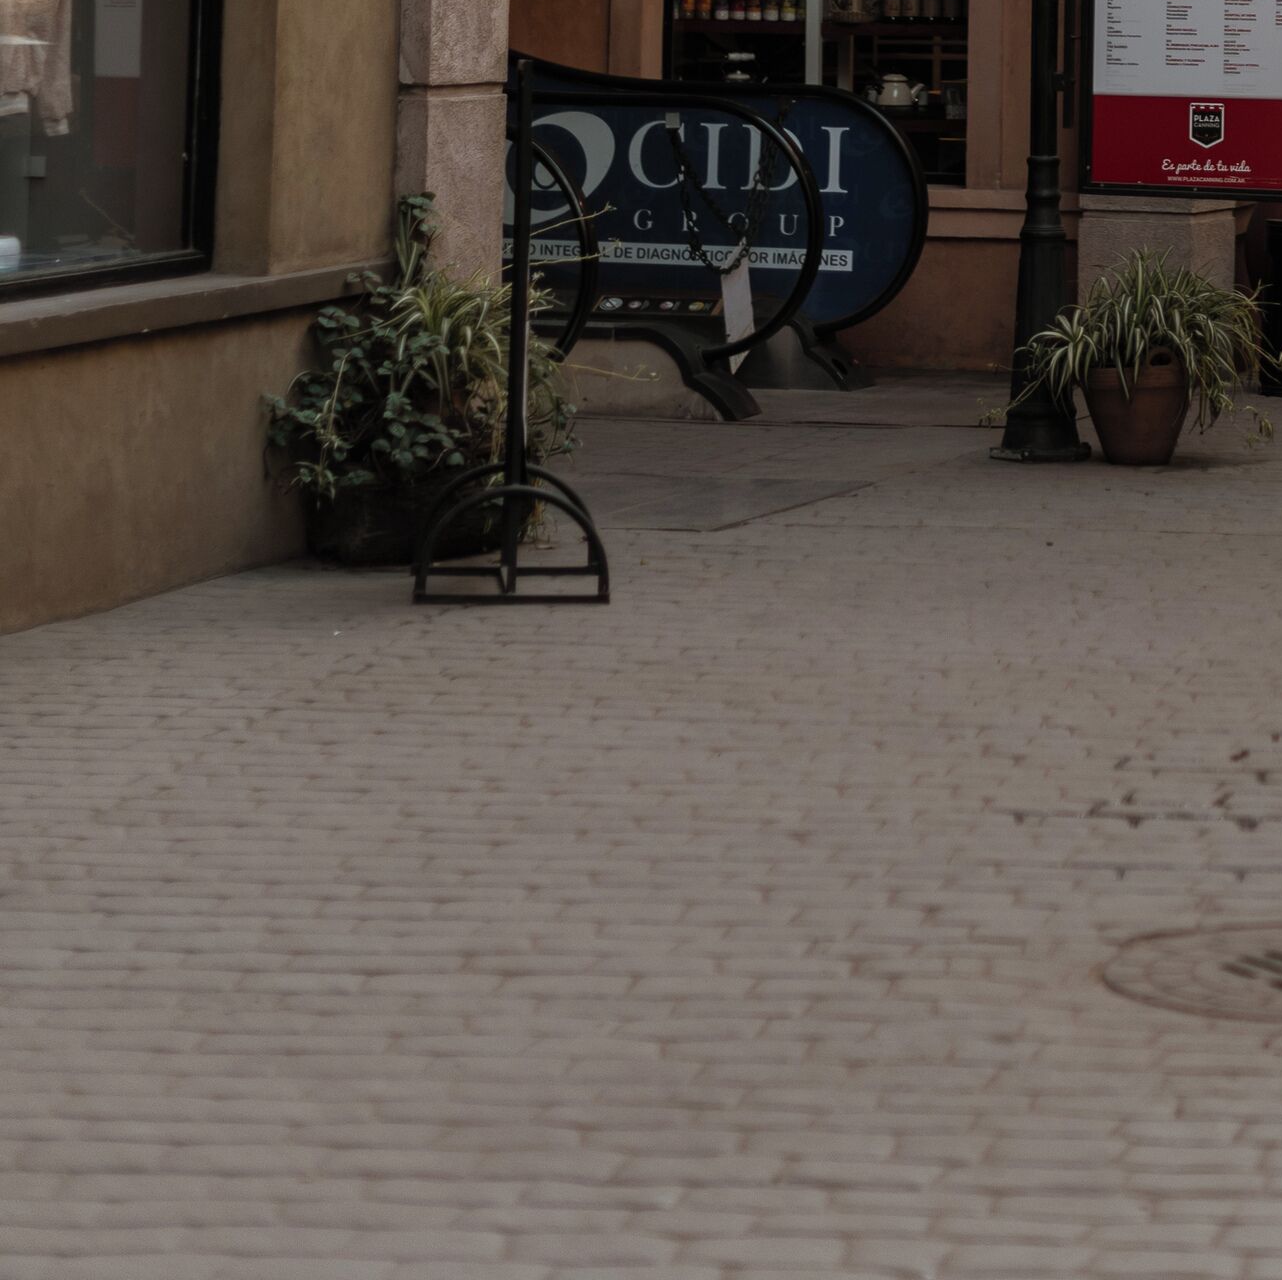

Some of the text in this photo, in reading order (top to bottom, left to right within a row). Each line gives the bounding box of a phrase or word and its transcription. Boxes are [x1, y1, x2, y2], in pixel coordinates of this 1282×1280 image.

[1193, 114, 1220, 123] PLAZA
[628, 120, 850, 194] CIDI
[1161, 158, 1252, 174] Es parte de tu vida
[633, 208, 845, 240] GROUP
[613, 246, 633, 259] DE
